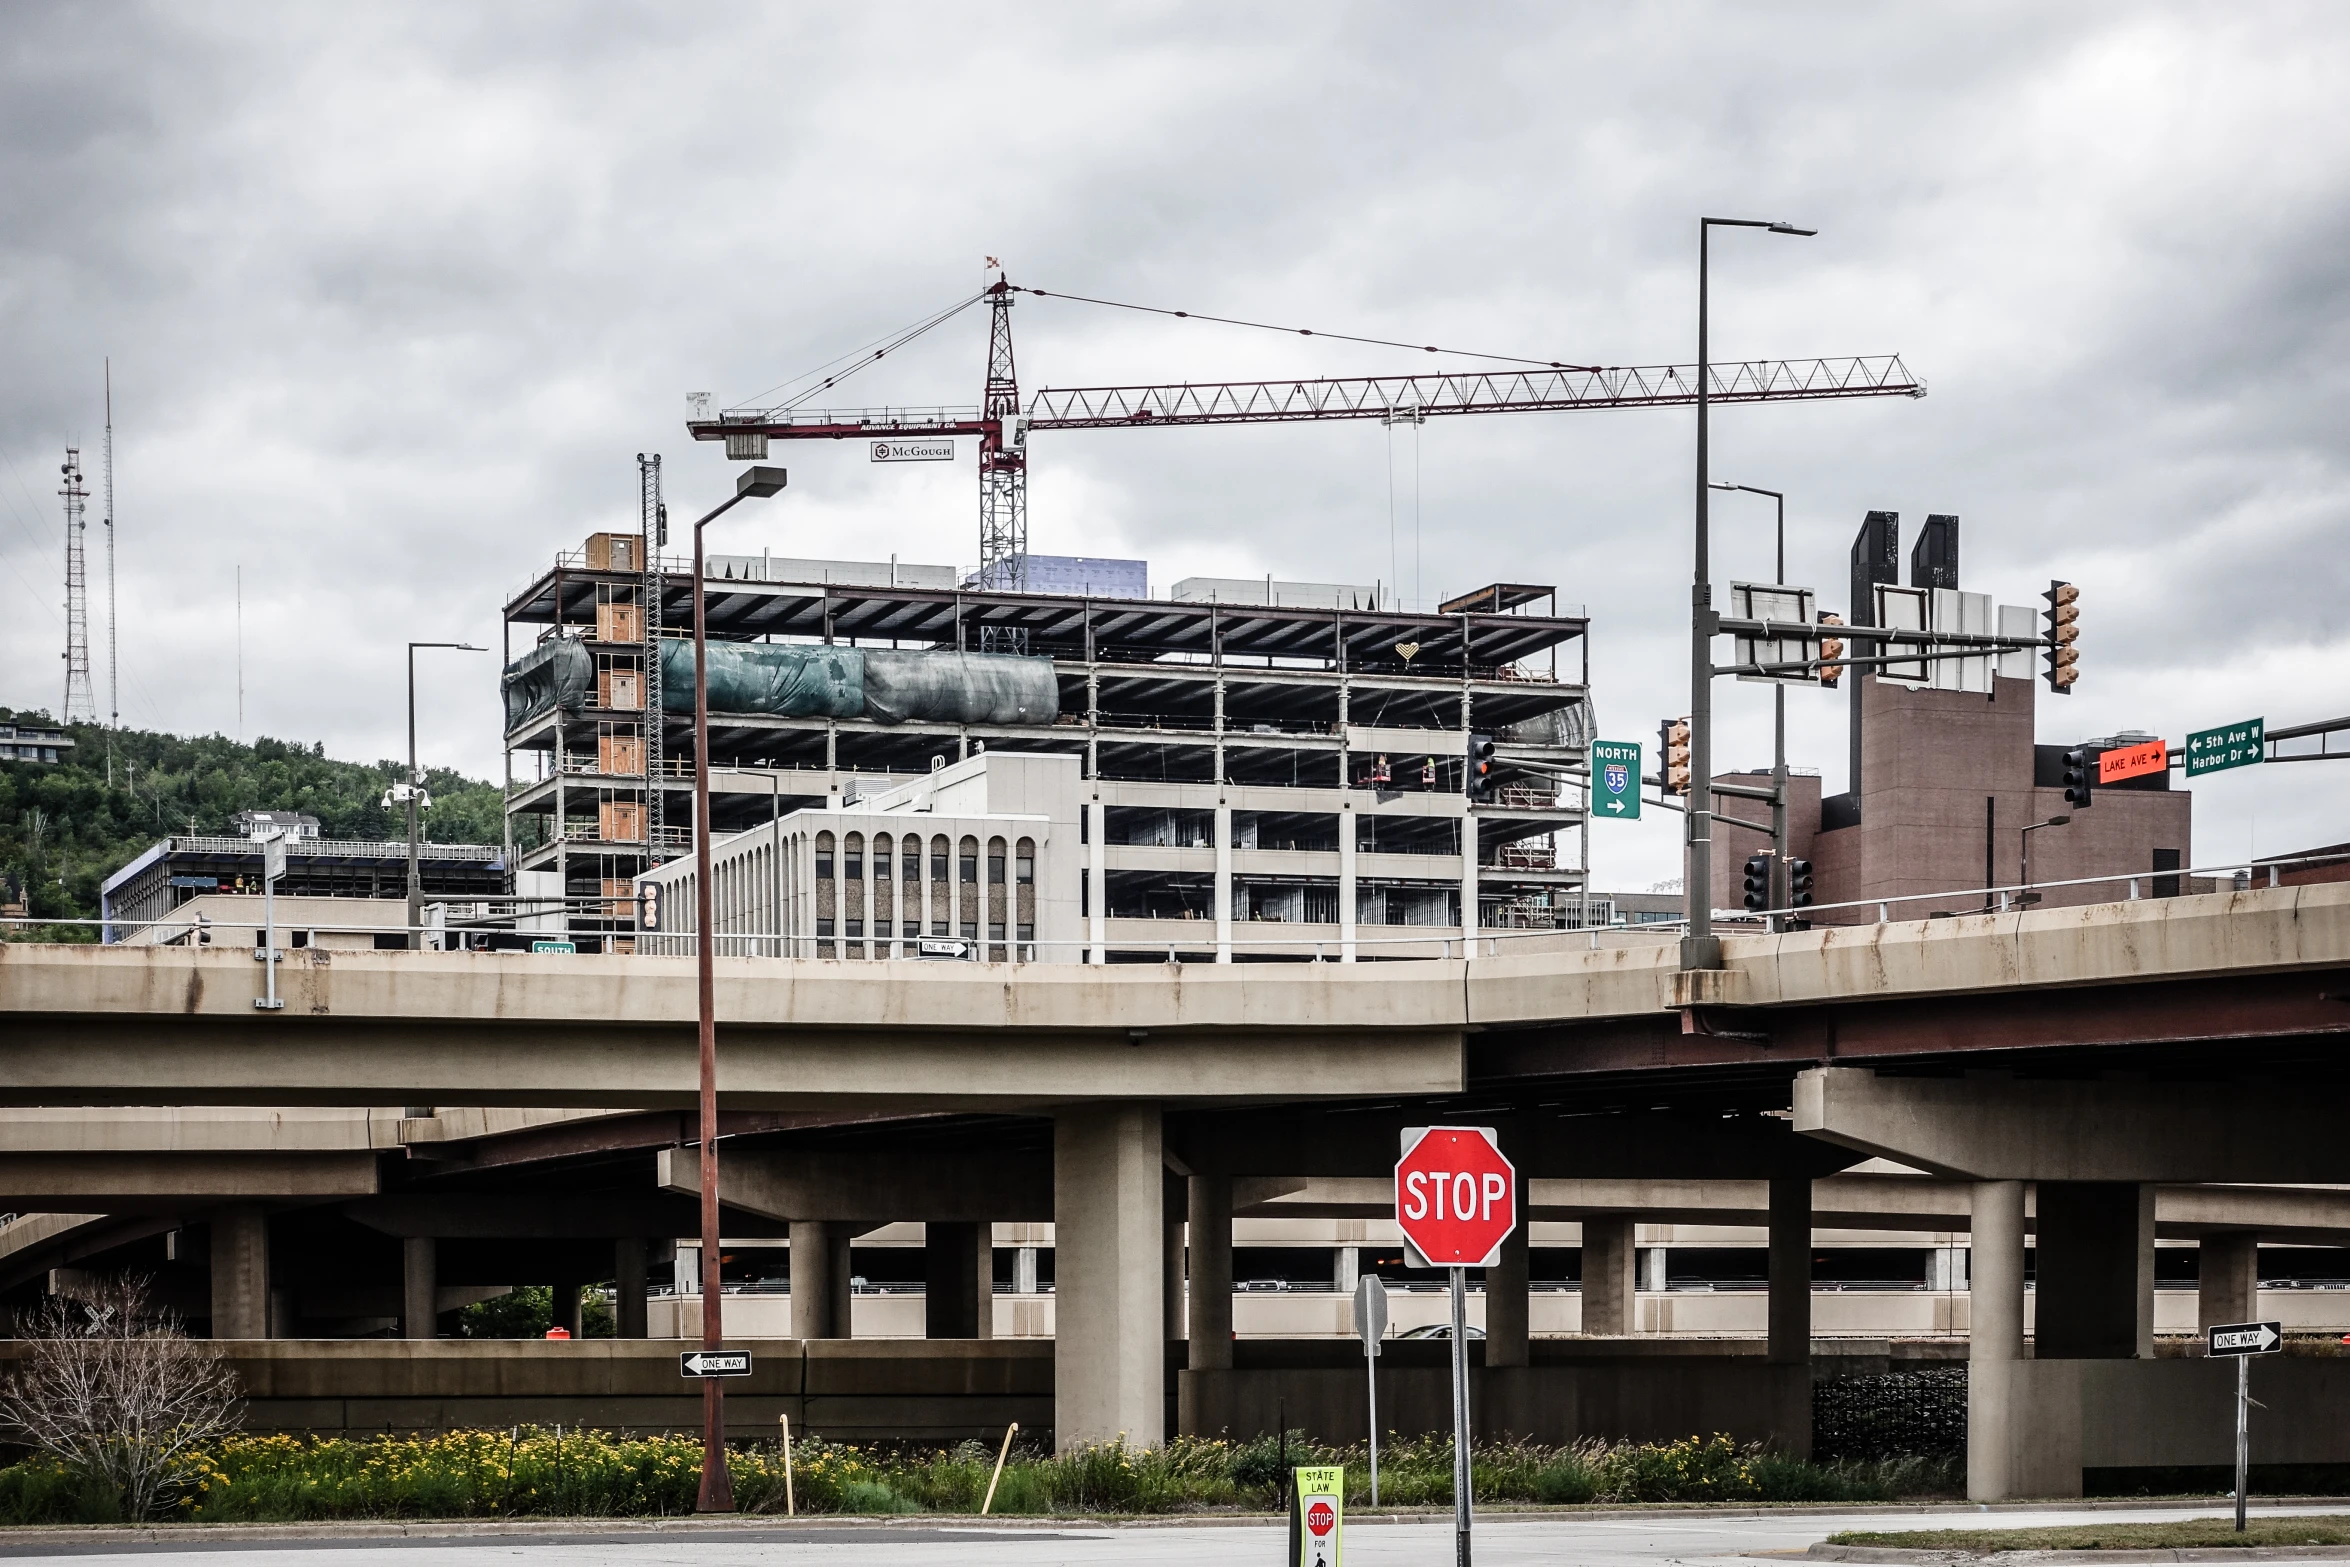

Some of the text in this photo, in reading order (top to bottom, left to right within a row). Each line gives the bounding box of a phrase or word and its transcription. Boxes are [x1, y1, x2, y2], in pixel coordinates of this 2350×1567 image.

[898, 422, 942, 430] EQUIPMENT
[2206, 725, 2259, 749] 5th Ave W
[1596, 746, 1637, 761] NORTH
[2192, 749, 2242, 770] Harbor Dr
[2104, 753, 2147, 773] LAKE AVE
[1608, 772, 1625, 788] 35
[537, 946, 571, 954] SOUTH
[923, 942, 937, 951] ONE
[1404, 1170, 1506, 1221] STOP
[2216, 1332, 2260, 1347] ONE WAY
[702, 1358, 743, 1369] ONE WAY
[1306, 1471, 1335, 1481] STATE
[1311, 1483, 1329, 1493] LAW
[1309, 1512, 1333, 1526] STOP
[1314, 1540, 1326, 1548] FOR
